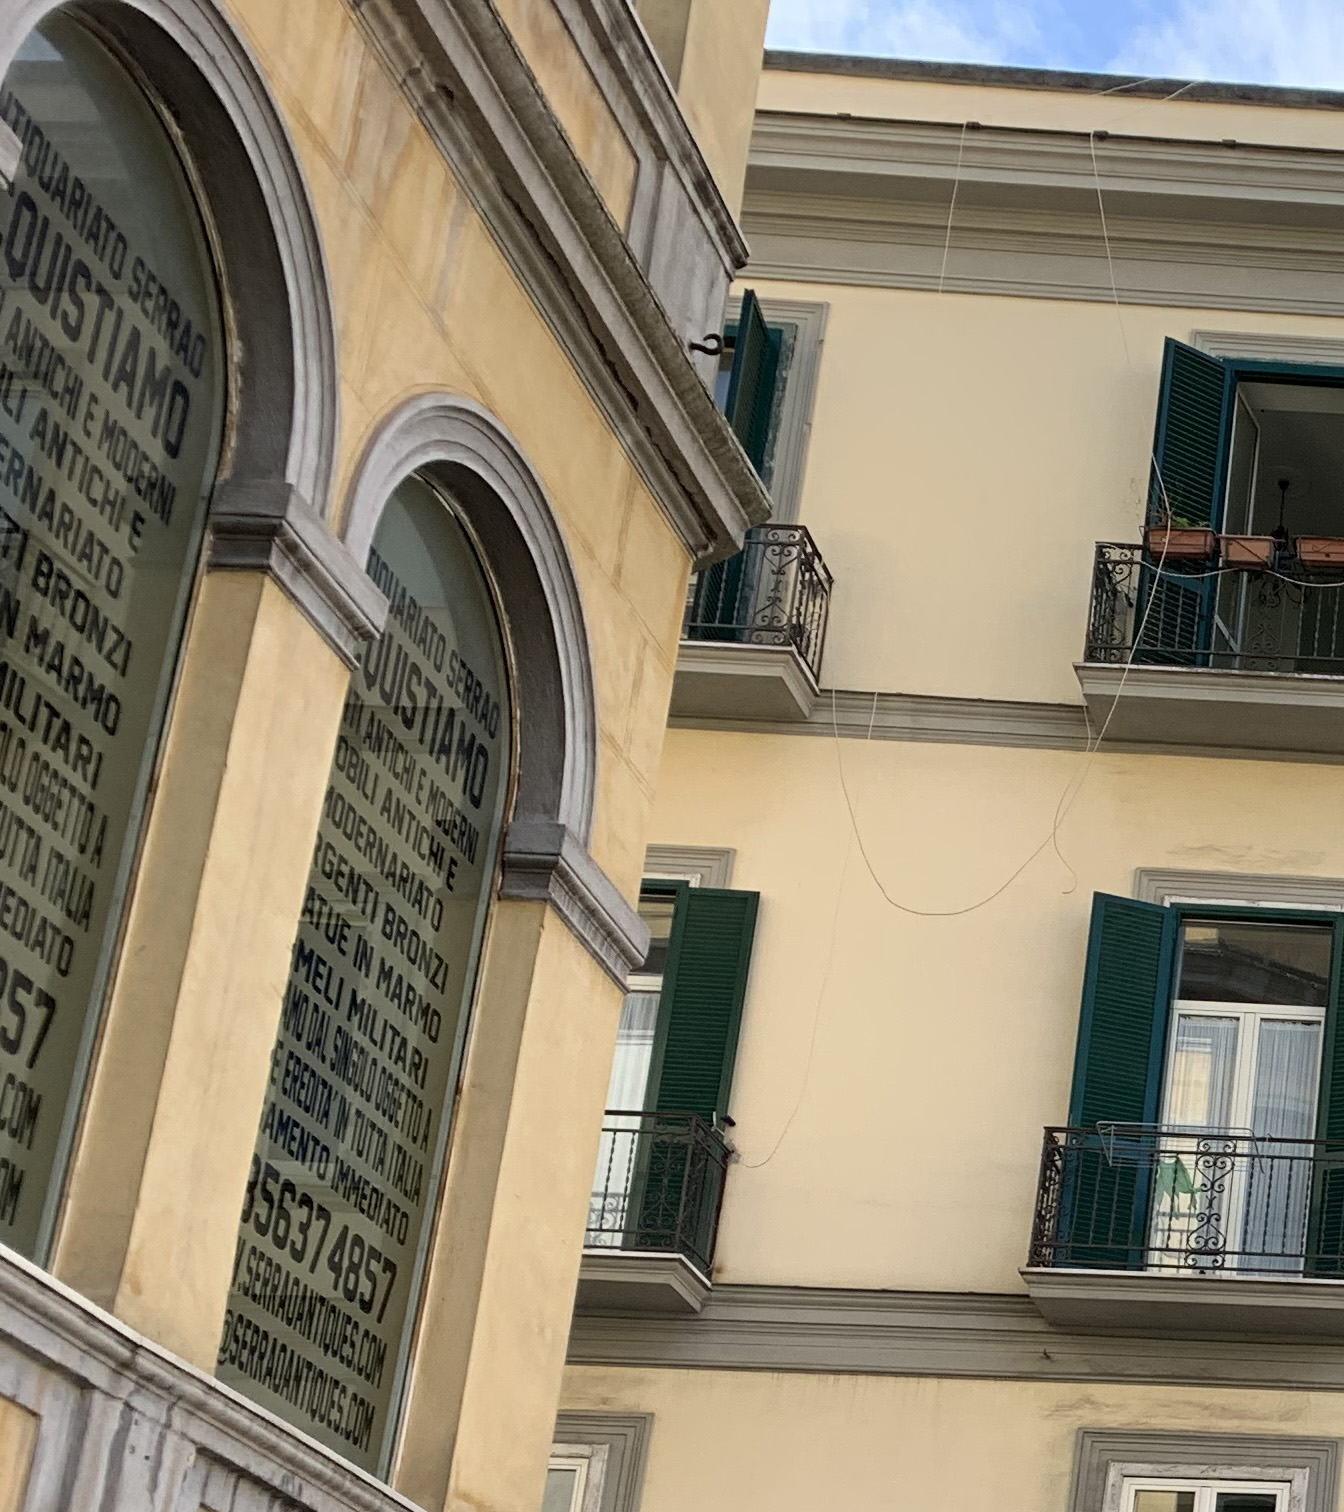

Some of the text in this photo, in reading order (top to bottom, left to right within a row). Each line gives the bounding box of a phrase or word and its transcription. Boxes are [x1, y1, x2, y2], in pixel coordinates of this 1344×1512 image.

[0, 190, 190, 460] QUISTIAMO
[128, 255, 206, 379] SERRAO
[4, 306, 177, 526] ANTICHI E MODERNI
[29, 407, 127, 533] ANTICHI
[127, 509, 146, 554] E
[24, 614, 121, 736] MARMO
[32, 548, 132, 678] BRONZI
[356, 630, 489, 809] QUISTIAMO
[446, 649, 500, 741] SERRAO
[23, 750, 95, 855] OGGETTO
[90, 813, 107, 869] A
[333, 734, 458, 893] OBILI ANTICHI E
[363, 710, 417, 795] ANTICHI
[415, 767, 427, 806] E
[425, 779, 480, 866] MODERNI
[0, 803, 94, 933] UTTA ITALIA
[0, 880, 74, 977] EDIATO
[353, 933, 375, 979] IN
[376, 956, 441, 1044] MARMO
[381, 901, 449, 996] BRONZI
[306, 1002, 331, 1065] DAL
[330, 1024, 378, 1104] SINGOLO
[374, 1065, 425, 1145] OGGETTO
[421, 1107, 433, 1153] A
[347, 987, 429, 1090] MILITARI
[331, 1155, 409, 1246] IMMEDIATO
[333, 1090, 352, 1144] IN
[351, 1107, 388, 1177] TUTTA
[387, 1140, 423, 1207] ITALIA
